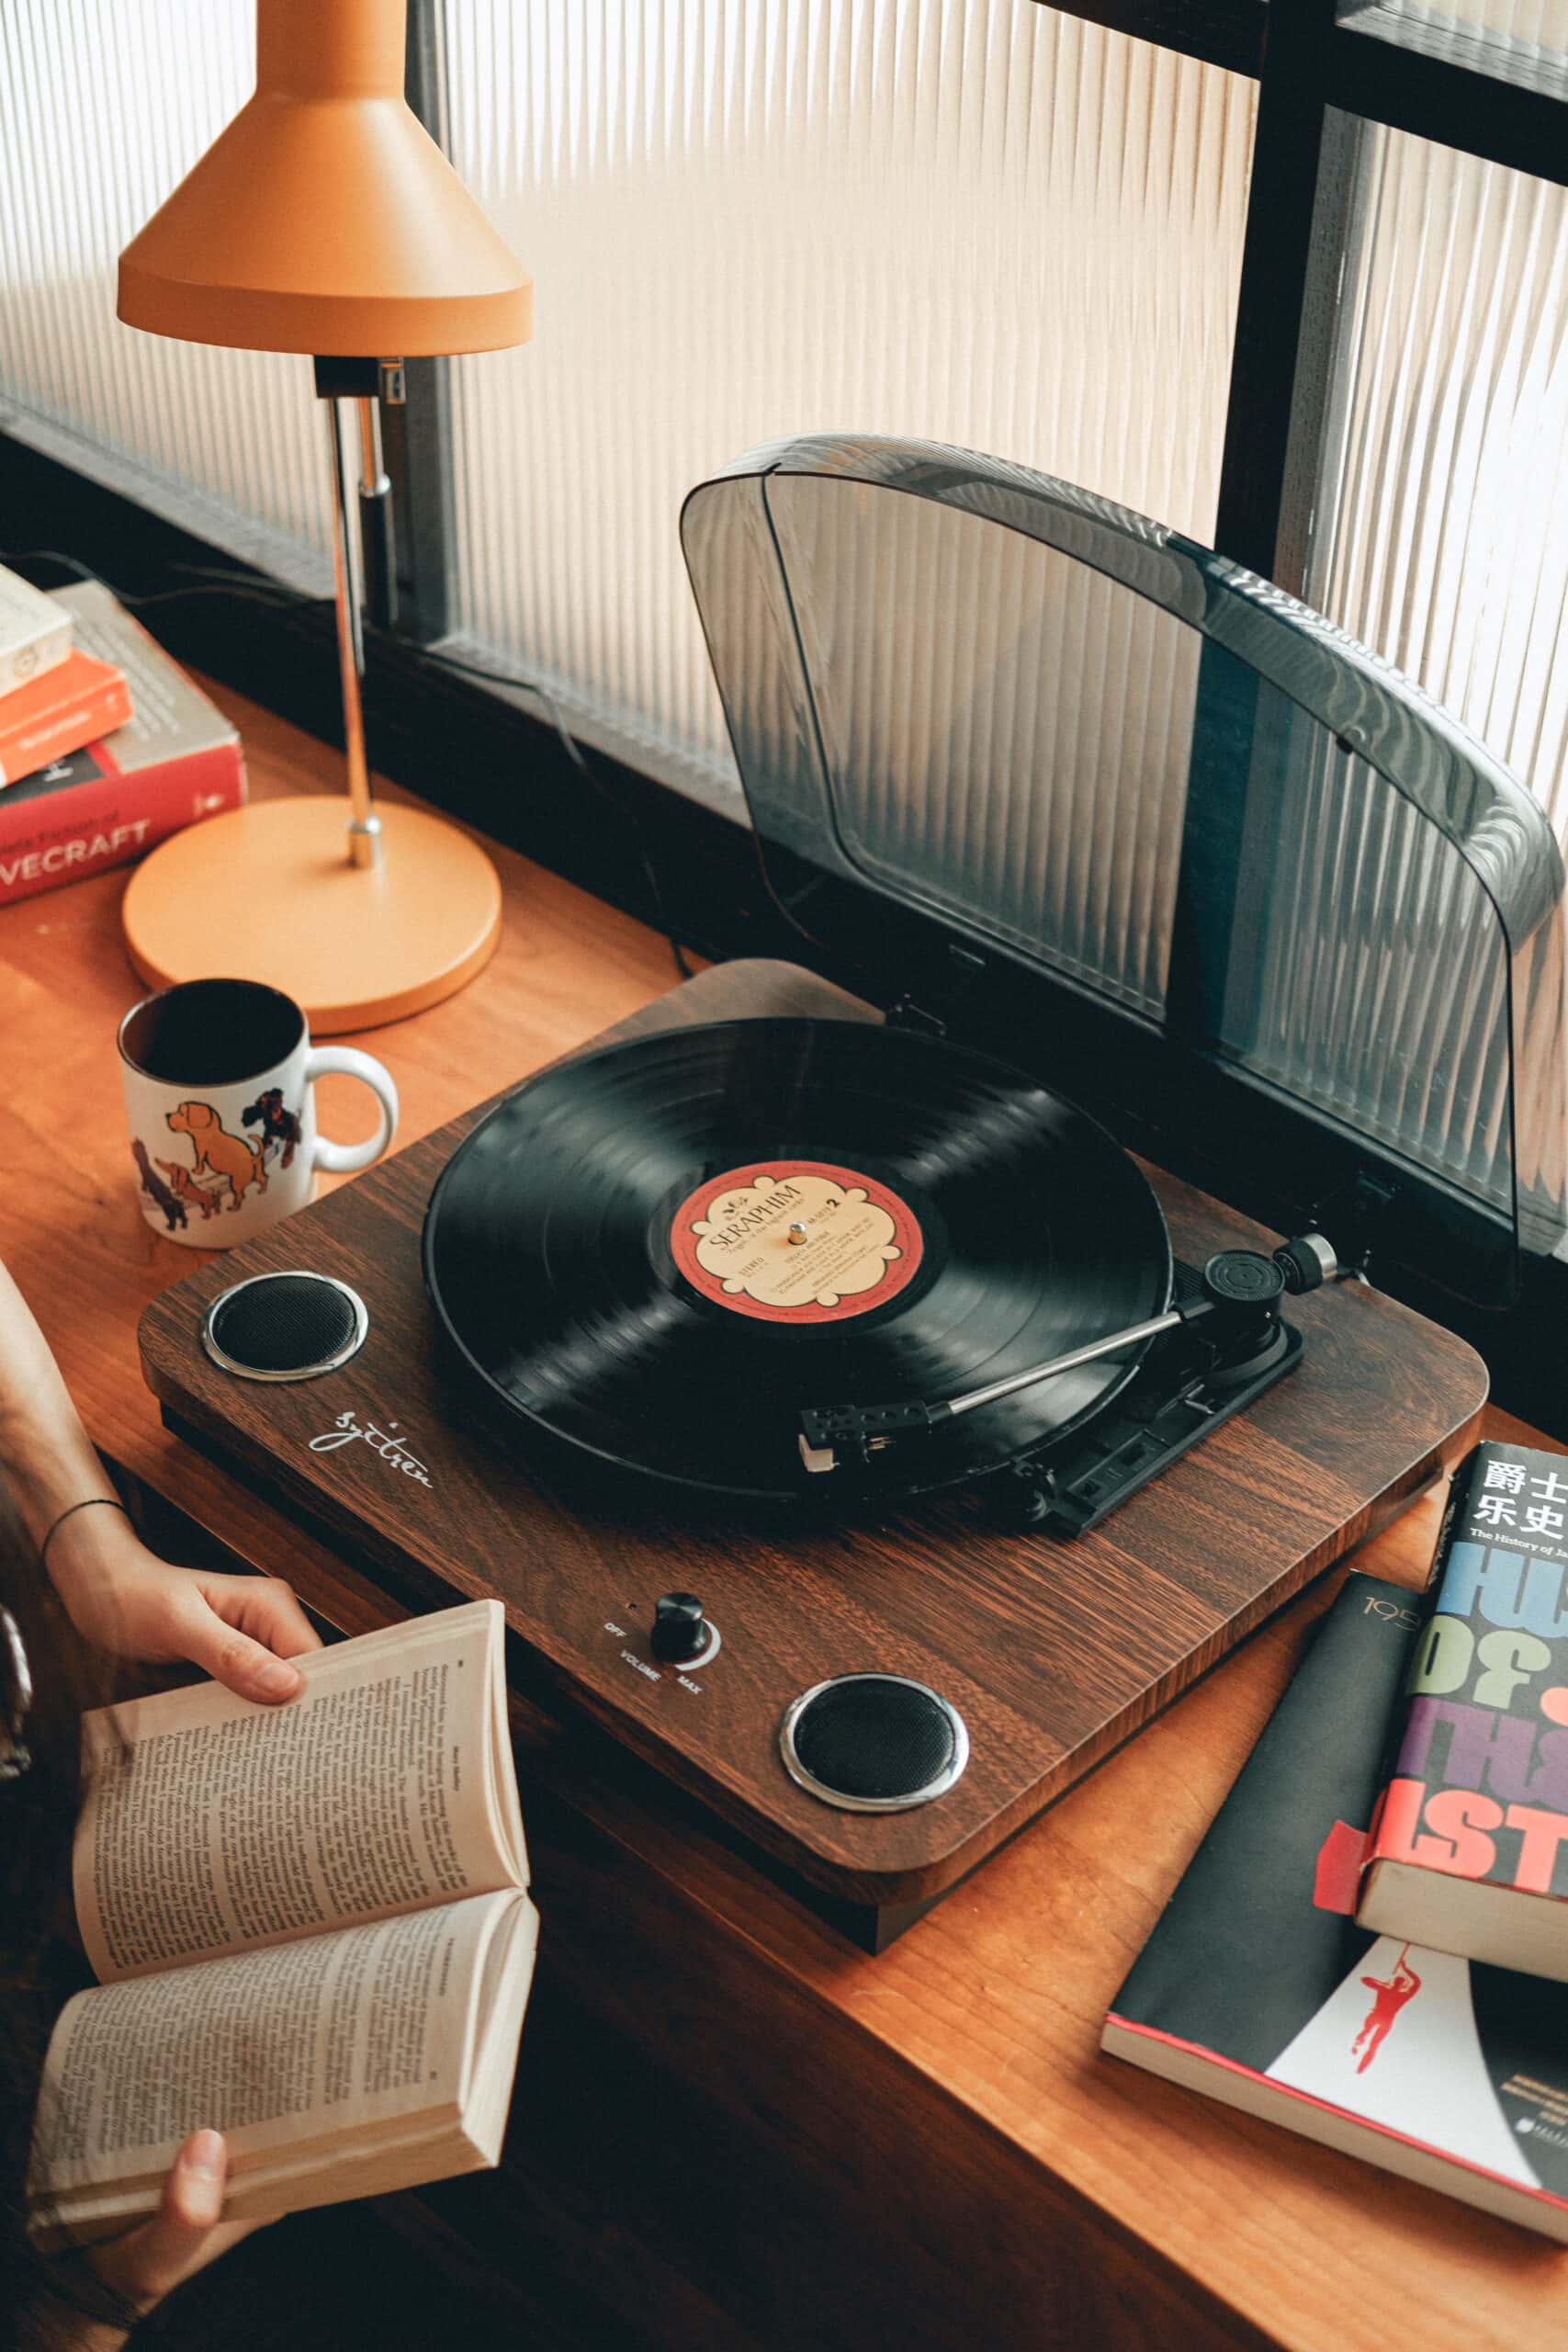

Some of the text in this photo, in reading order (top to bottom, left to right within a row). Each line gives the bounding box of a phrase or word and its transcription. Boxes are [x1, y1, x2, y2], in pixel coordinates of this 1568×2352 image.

[710, 1184, 803, 1250] SERAPHIM
[826, 1198, 841, 1208] 2
[1483, 1460, 1568, 1504] 爵士
[1473, 1494, 1565, 1540] 乐史
[1470, 1528, 1493, 1541] The
[1495, 1533, 1539, 1552] History
[1540, 1546, 1555, 1555] of
[604, 1622, 626, 1637] OFF
[620, 1649, 661, 1681] VOLUME
[677, 1675, 703, 1694] MAX
